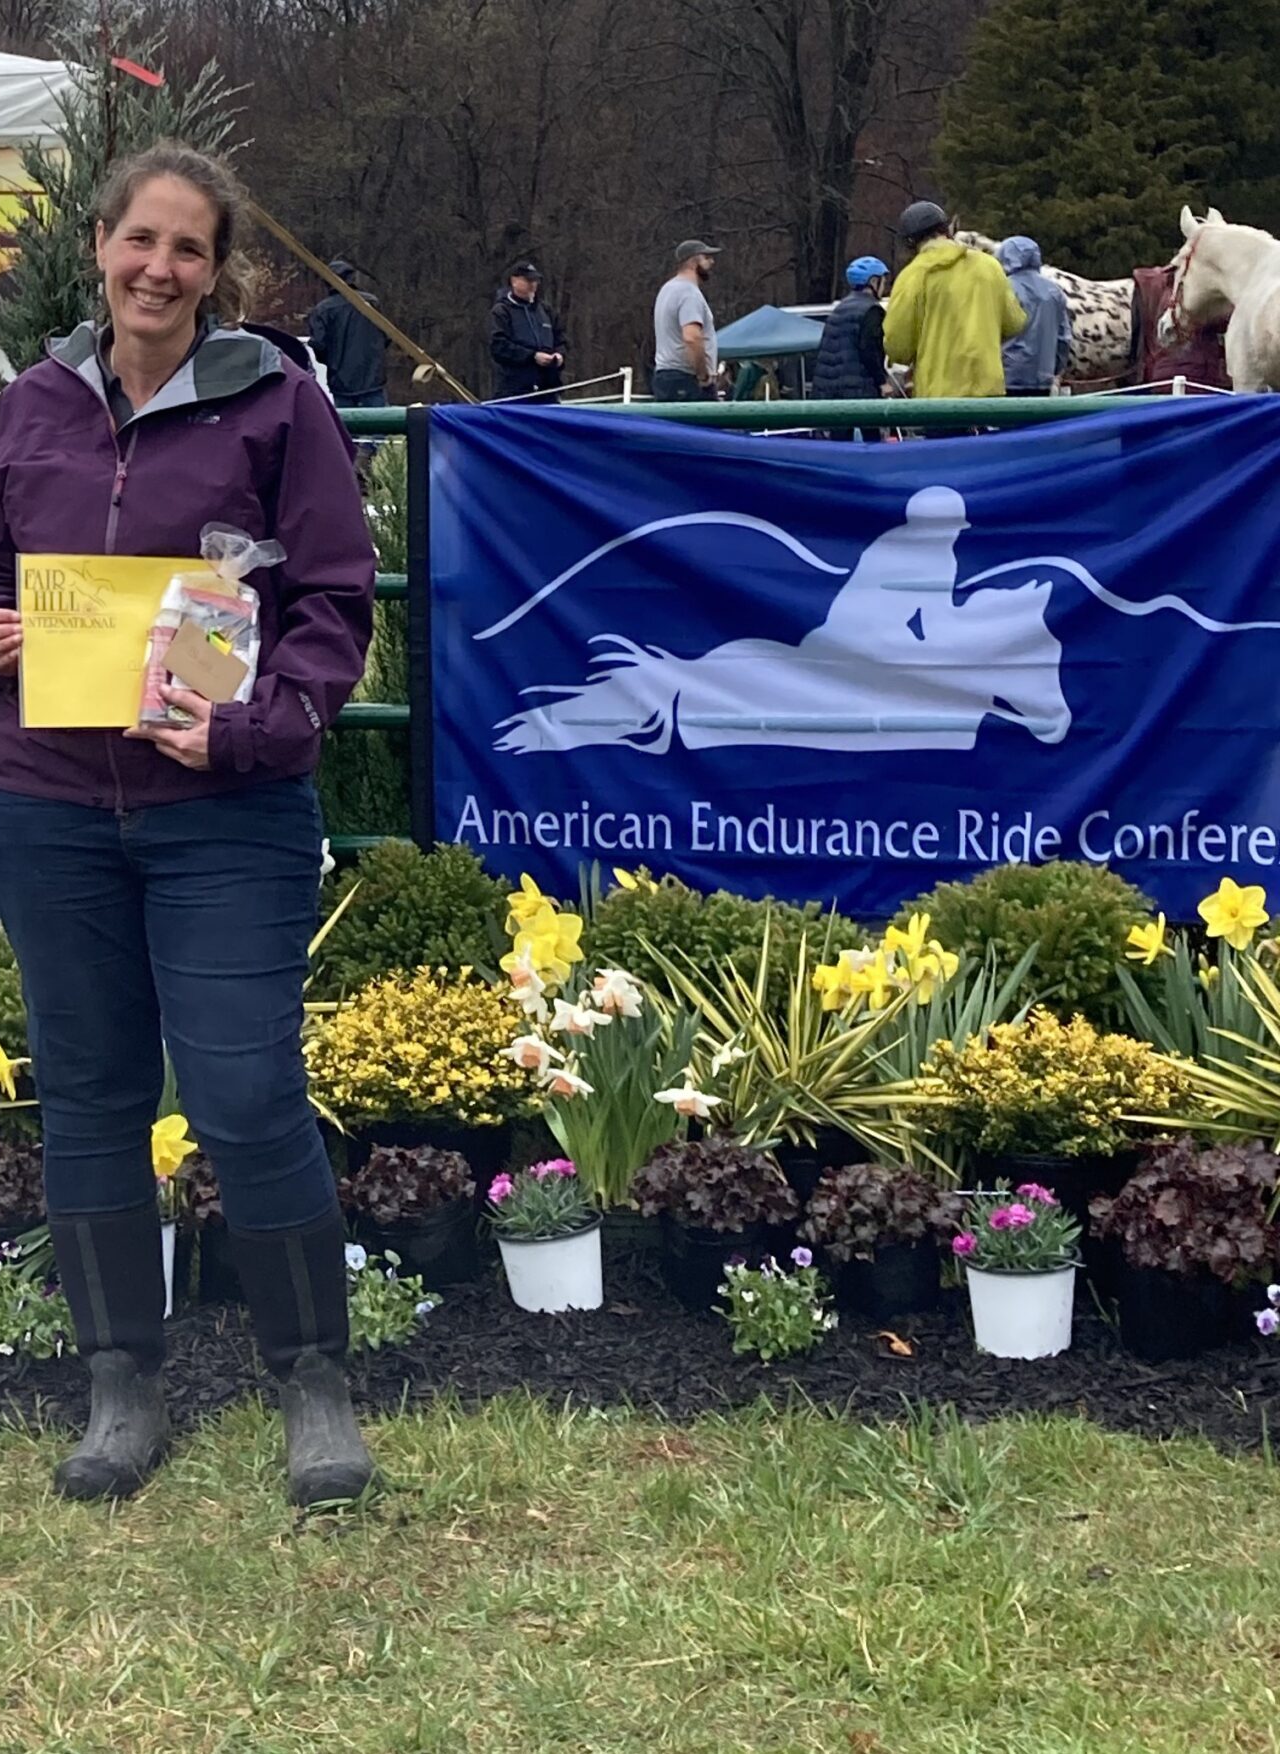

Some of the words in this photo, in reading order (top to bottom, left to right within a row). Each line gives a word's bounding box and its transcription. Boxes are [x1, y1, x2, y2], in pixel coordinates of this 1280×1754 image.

[23, 568, 66, 591] FAIR
[33, 590, 81, 612] HILL
[452, 795, 673, 850] American
[690, 800, 941, 859] Endurance
[957, 809, 1062, 864] Ride
[1078, 809, 1280, 866] Confere
